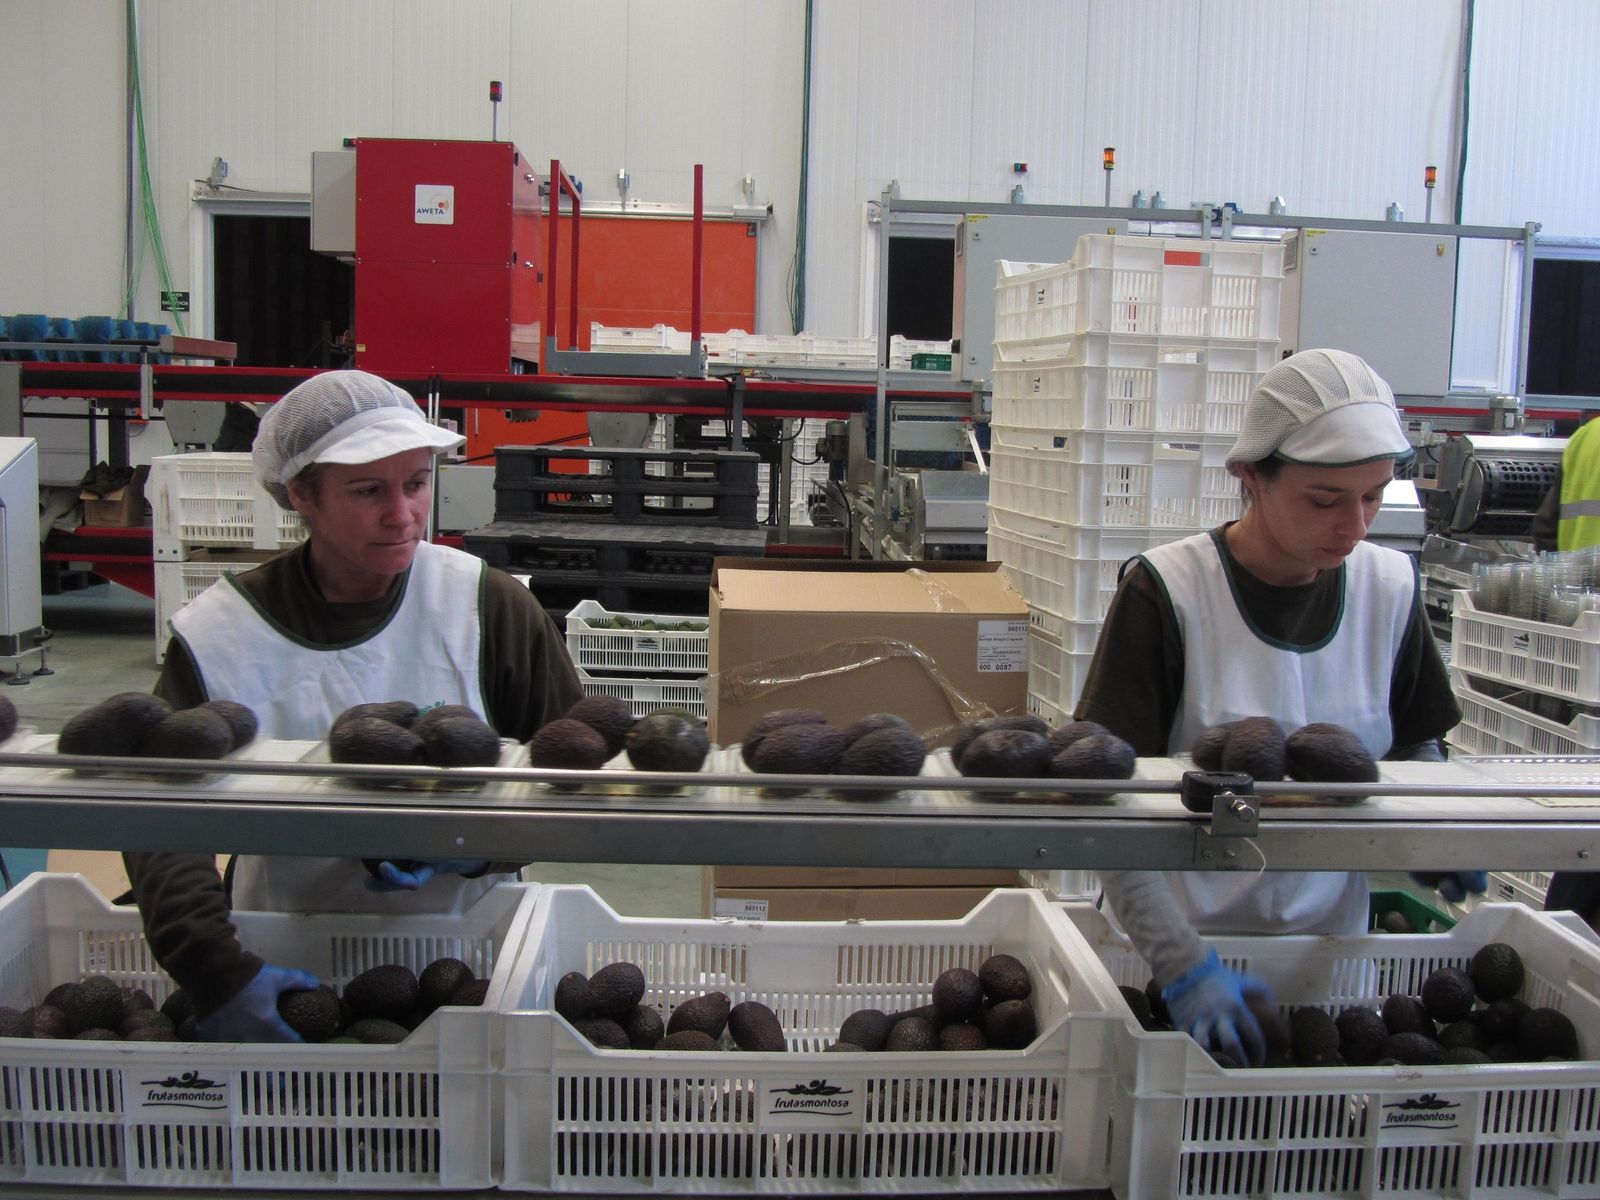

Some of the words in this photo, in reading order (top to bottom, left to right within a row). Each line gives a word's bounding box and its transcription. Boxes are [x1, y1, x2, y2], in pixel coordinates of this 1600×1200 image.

[416, 207, 445, 215] AWETA
[147, 1089, 224, 1101] frutasmontosa
[774, 1097, 850, 1109] frutasmontosa
[1386, 1112, 1457, 1123] frutasmontosa
